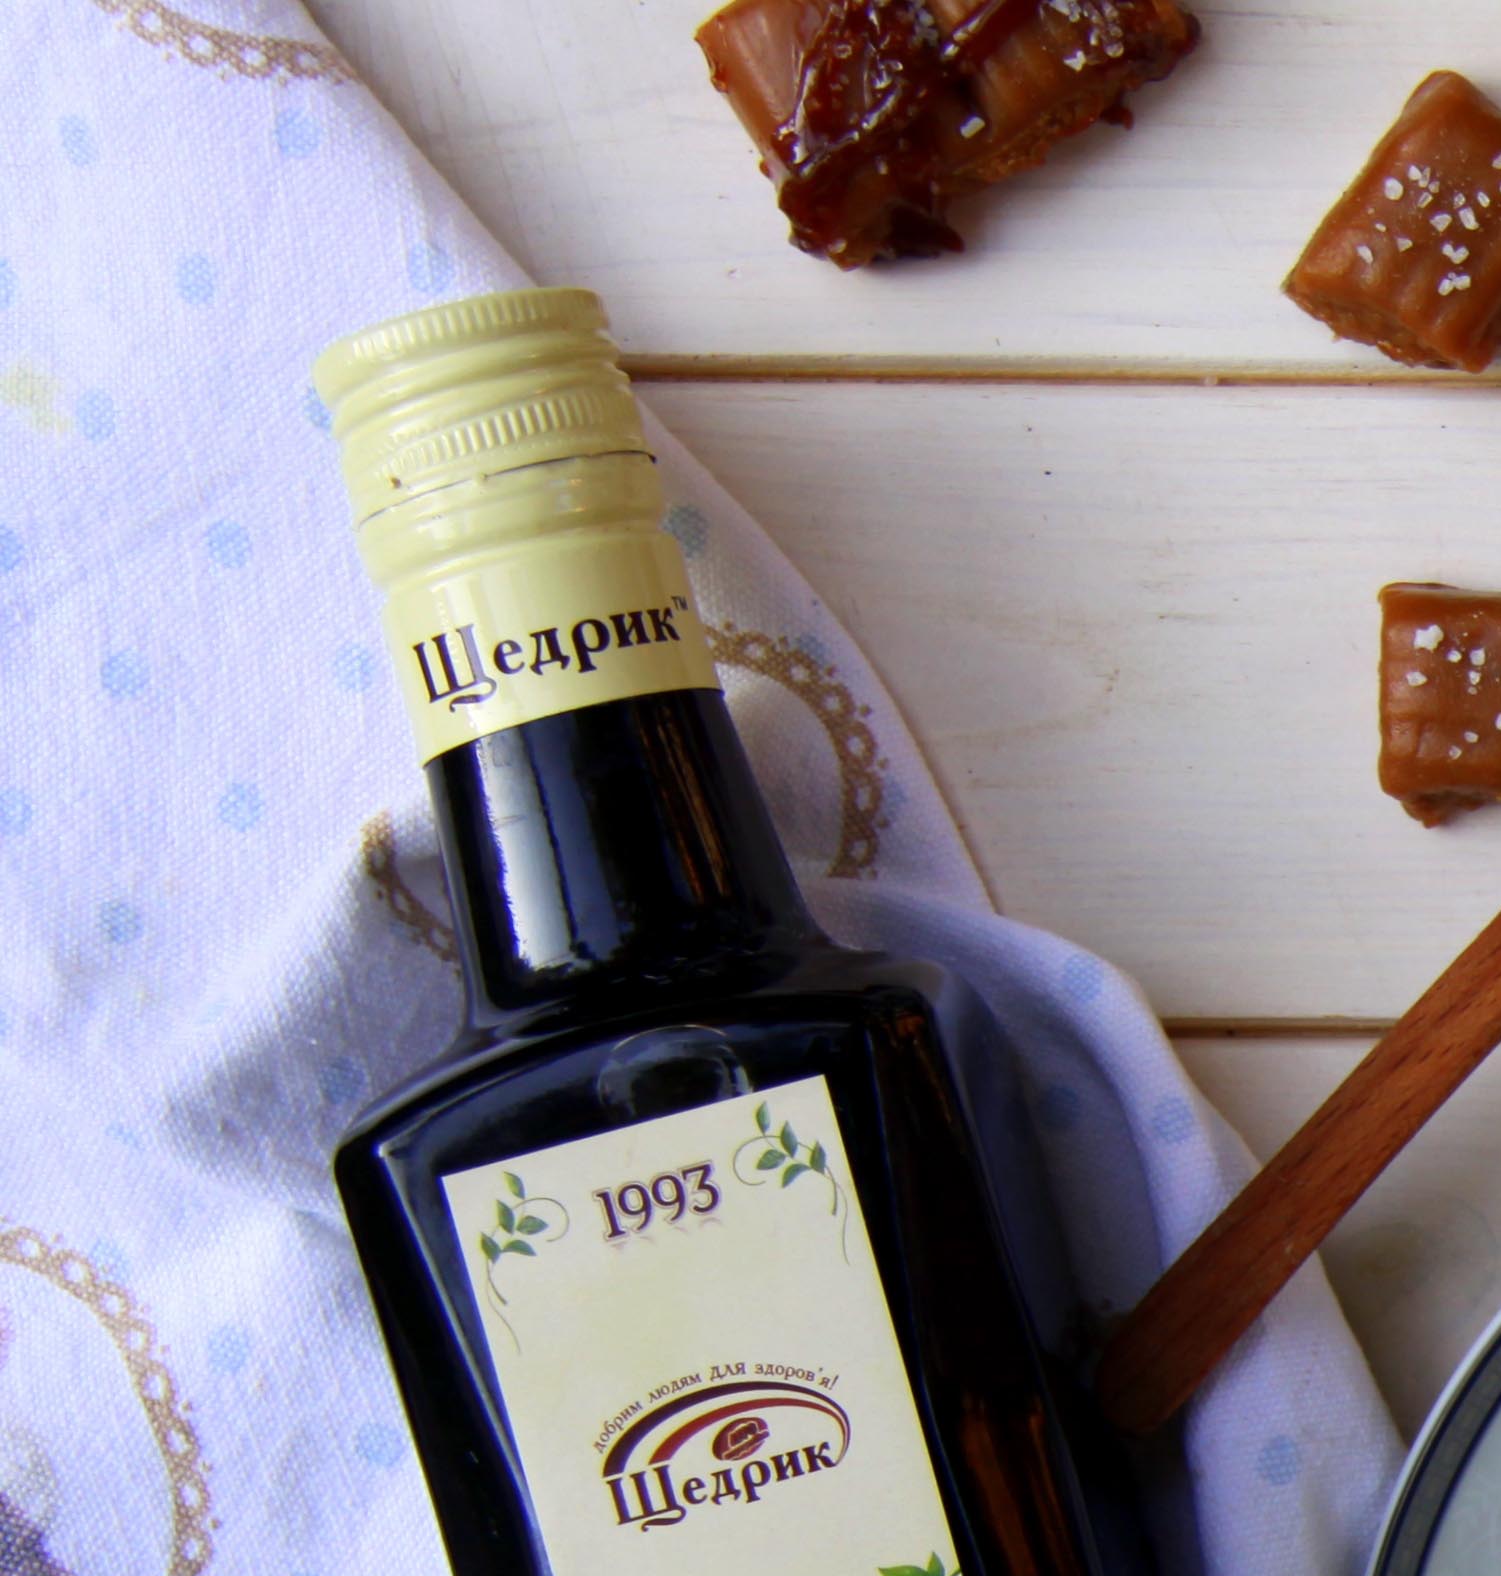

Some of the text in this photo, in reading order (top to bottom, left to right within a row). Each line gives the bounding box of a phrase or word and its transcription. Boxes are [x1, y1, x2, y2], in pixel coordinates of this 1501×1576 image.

[594, 1161, 721, 1241] 1993
[592, 1401, 643, 1455] добрим
[648, 1372, 702, 1403] людям
[605, 1441, 838, 1532] Щедрик
